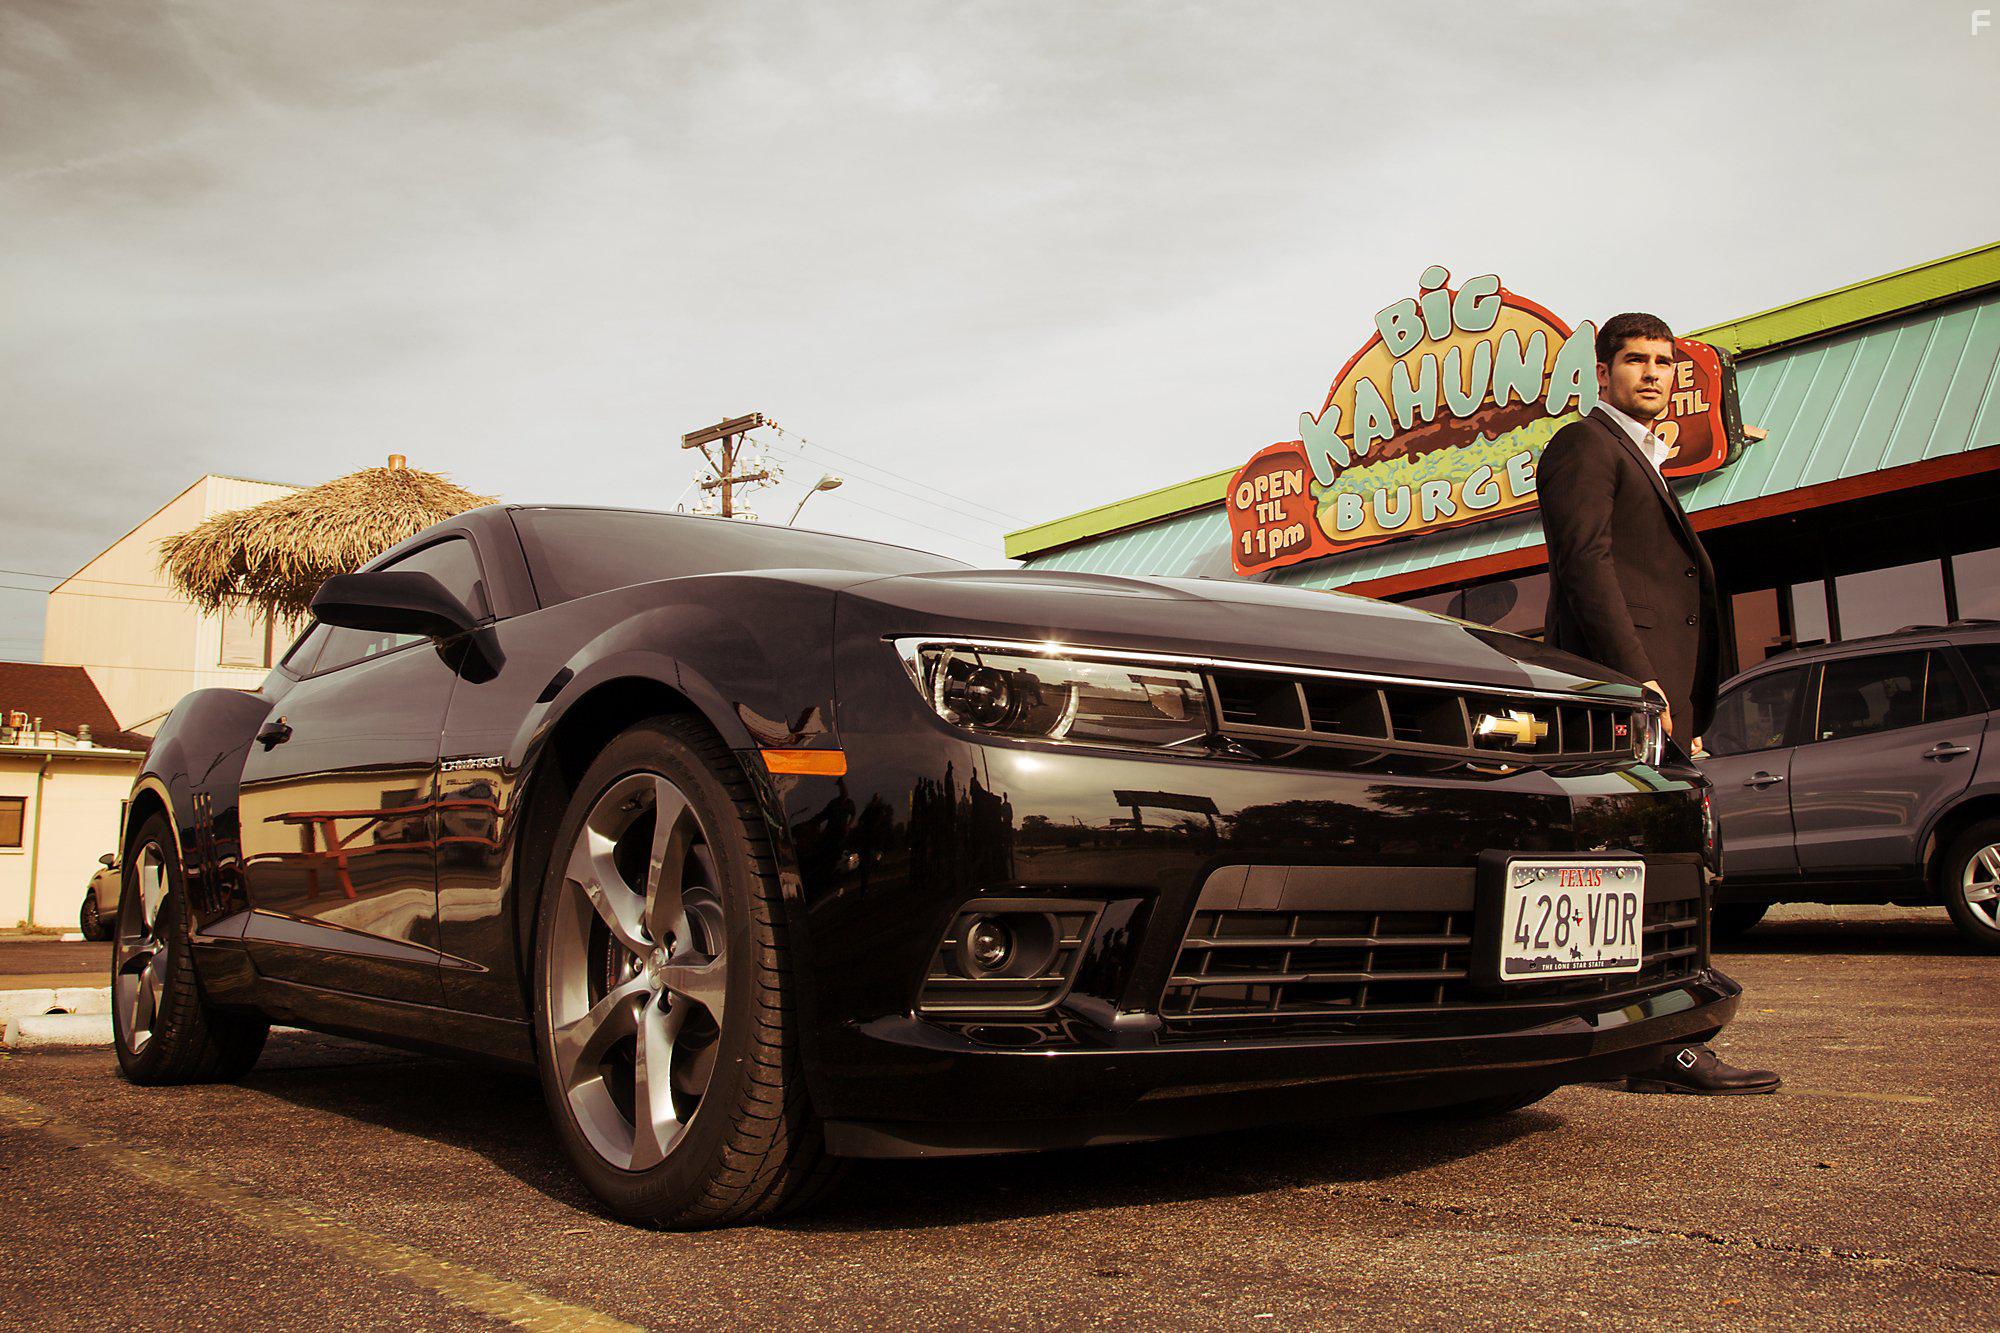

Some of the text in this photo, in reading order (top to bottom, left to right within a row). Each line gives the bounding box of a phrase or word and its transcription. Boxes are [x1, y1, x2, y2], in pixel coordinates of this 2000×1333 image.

[1299, 320, 1600, 487] KAHUNA
[1235, 469, 1303, 510] OPEN
[1336, 442, 1550, 531] BURGE
[1255, 499, 1287, 524] TIL
[1241, 522, 1305, 559] 11pm
[1559, 868, 1603, 888] TEXAS
[1514, 892, 1637, 950] 428 VDR
